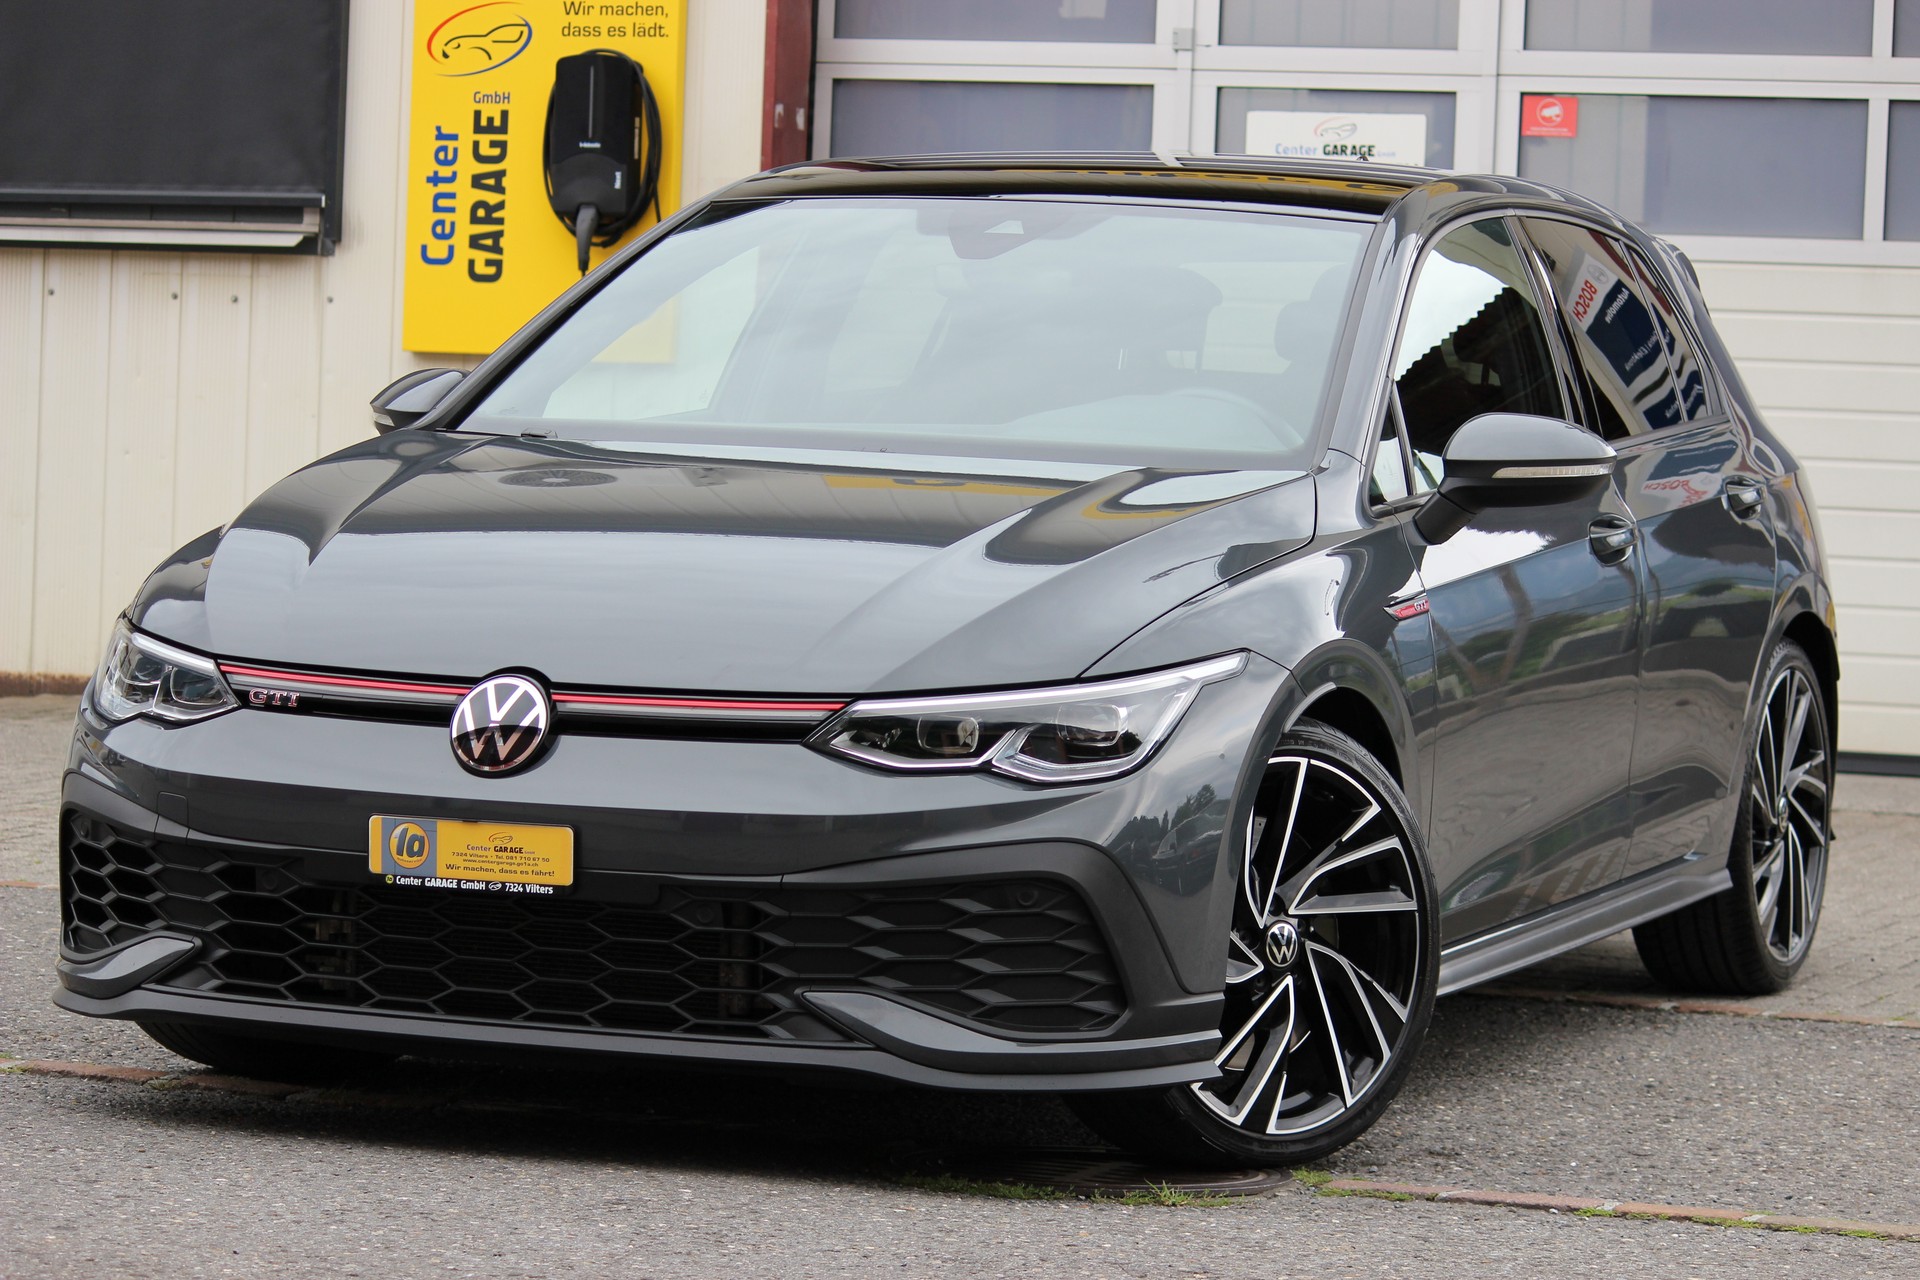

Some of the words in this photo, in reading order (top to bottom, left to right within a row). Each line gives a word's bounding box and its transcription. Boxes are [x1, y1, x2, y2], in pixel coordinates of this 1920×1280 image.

[563, 1, 594, 16] Wir
[600, 1, 668, 18] machen,
[562, 22, 601, 37] dass
[607, 26, 626, 37] es
[632, 22, 669, 37] lädt.
[473, 91, 510, 104] GmbH
[1275, 143, 1318, 156] Center
[1323, 144, 1375, 156] GARAGE
[421, 125, 459, 265] Center
[468, 110, 510, 284] GARAGE
[249, 687, 299, 707] GTI
[466, 844, 491, 852] Center
[494, 845, 524, 854] GARAGE
[463, 865, 497, 874] machen,
[499, 867, 518, 875] dass
[396, 876, 422, 886] Center
[425, 878, 458, 888] GARAGE
[460, 880, 485, 890] GmbH
[505, 882, 523, 892] 7324
[525, 883, 553, 894] Vilters
